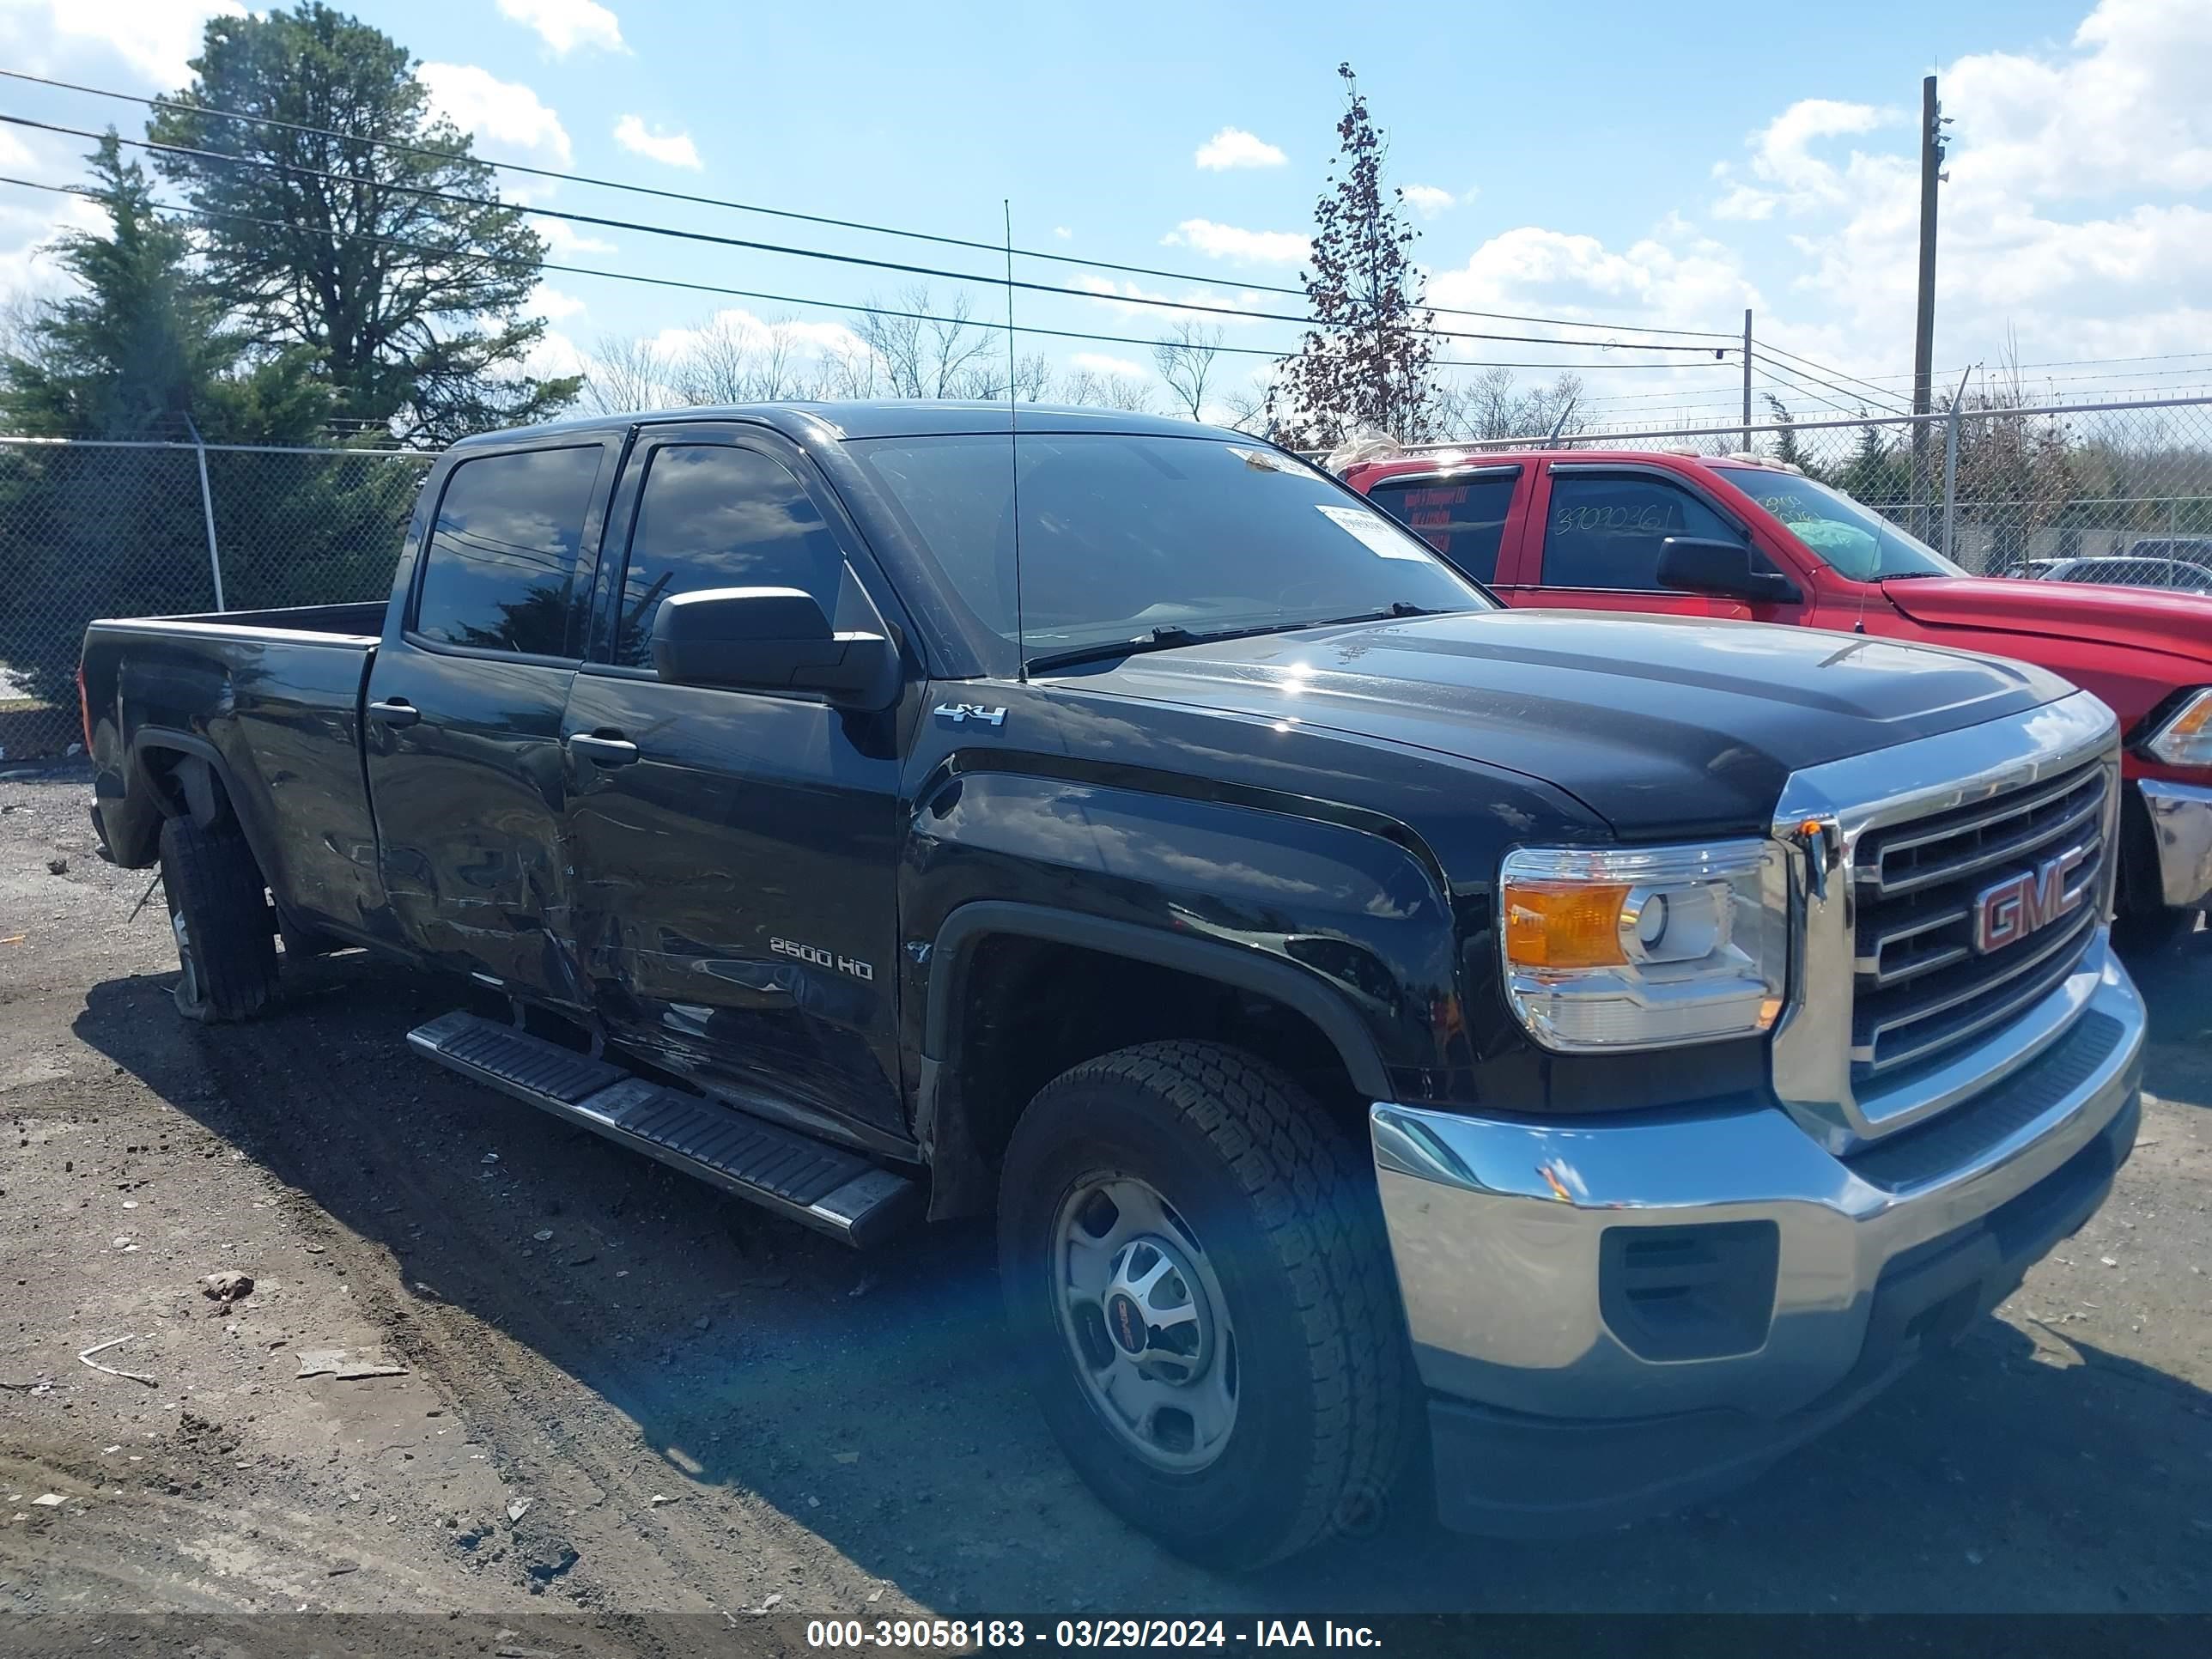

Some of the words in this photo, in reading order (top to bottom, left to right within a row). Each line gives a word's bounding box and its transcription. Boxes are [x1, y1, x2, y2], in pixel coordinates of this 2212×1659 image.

[1977, 846, 2082, 954] GMC
[769, 937, 832, 968] 2500
[838, 955, 872, 981] HD
[1118, 1300, 1135, 1349] GMC
